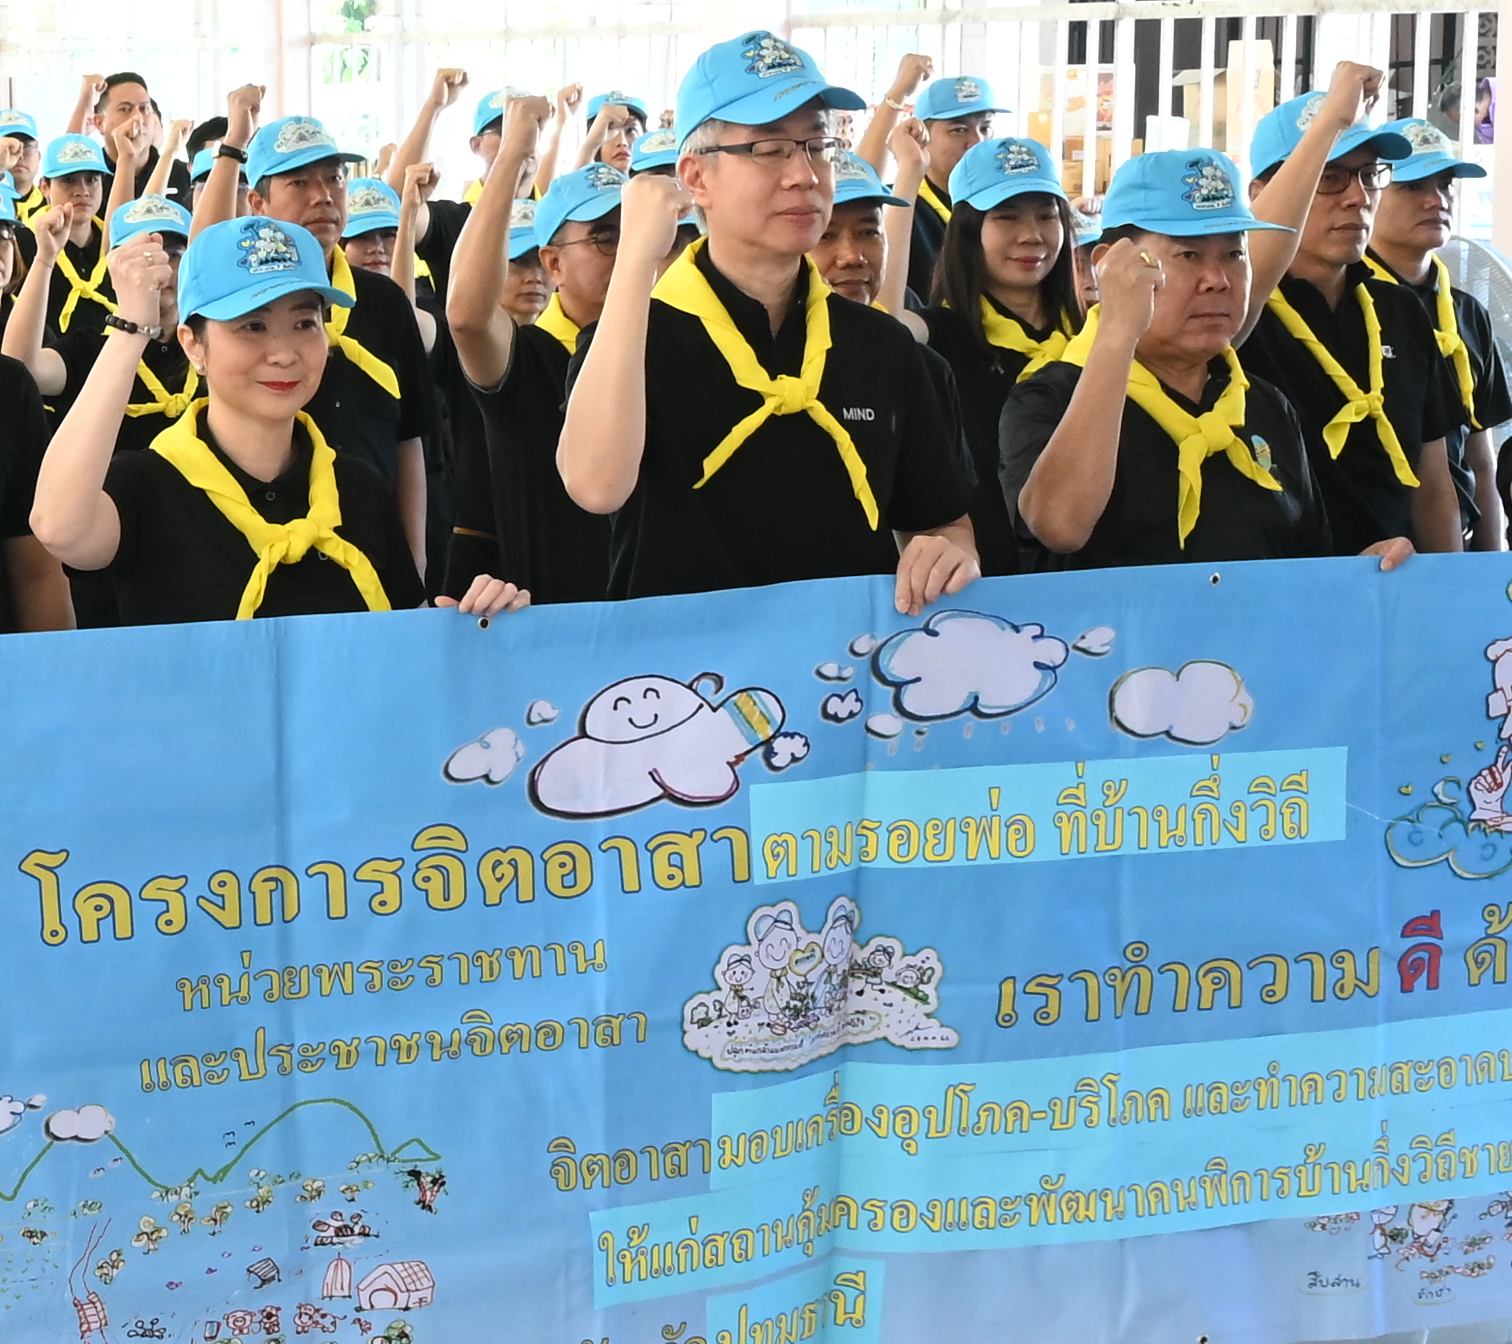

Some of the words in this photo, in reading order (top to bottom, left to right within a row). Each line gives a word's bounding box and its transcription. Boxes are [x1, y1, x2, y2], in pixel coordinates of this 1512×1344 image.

[842, 407, 875, 421] MIND
[1054, 755, 1309, 854] ที่บ้านกึ่งวิถี
[175, 938, 608, 1013] หน่วยพระราชทาน
[995, 942, 1380, 1029] เราทำความ
[1396, 909, 1444, 994] ดี
[139, 1009, 648, 1094] และประชาชนจิตอาสา
